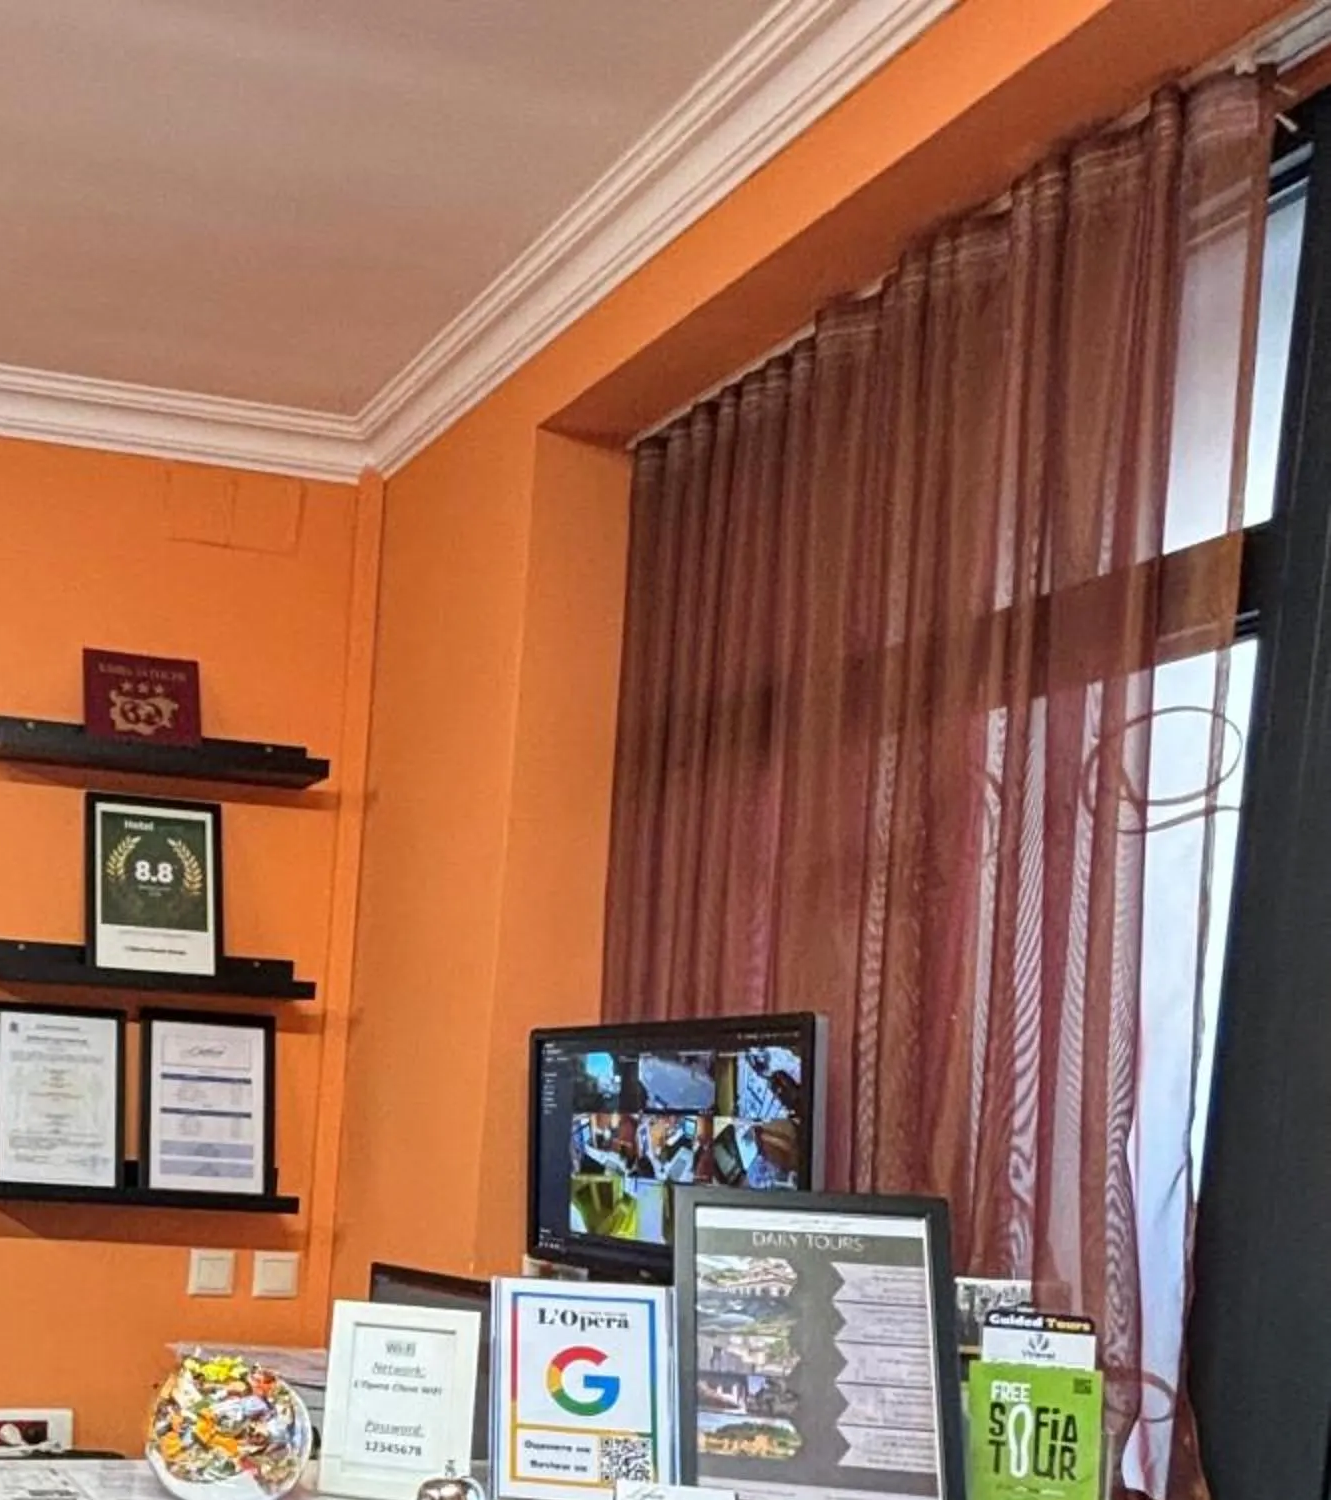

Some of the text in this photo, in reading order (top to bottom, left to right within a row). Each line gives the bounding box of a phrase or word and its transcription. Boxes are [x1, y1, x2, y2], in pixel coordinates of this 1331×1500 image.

[134, 859, 174, 883] 8.8
[752, 1231, 864, 1252] DAILY TOURS
[989, 1313, 1091, 1331] Guided Tours
[990, 1380, 1031, 1403] FREE
[364, 1440, 422, 1457] 12345678
